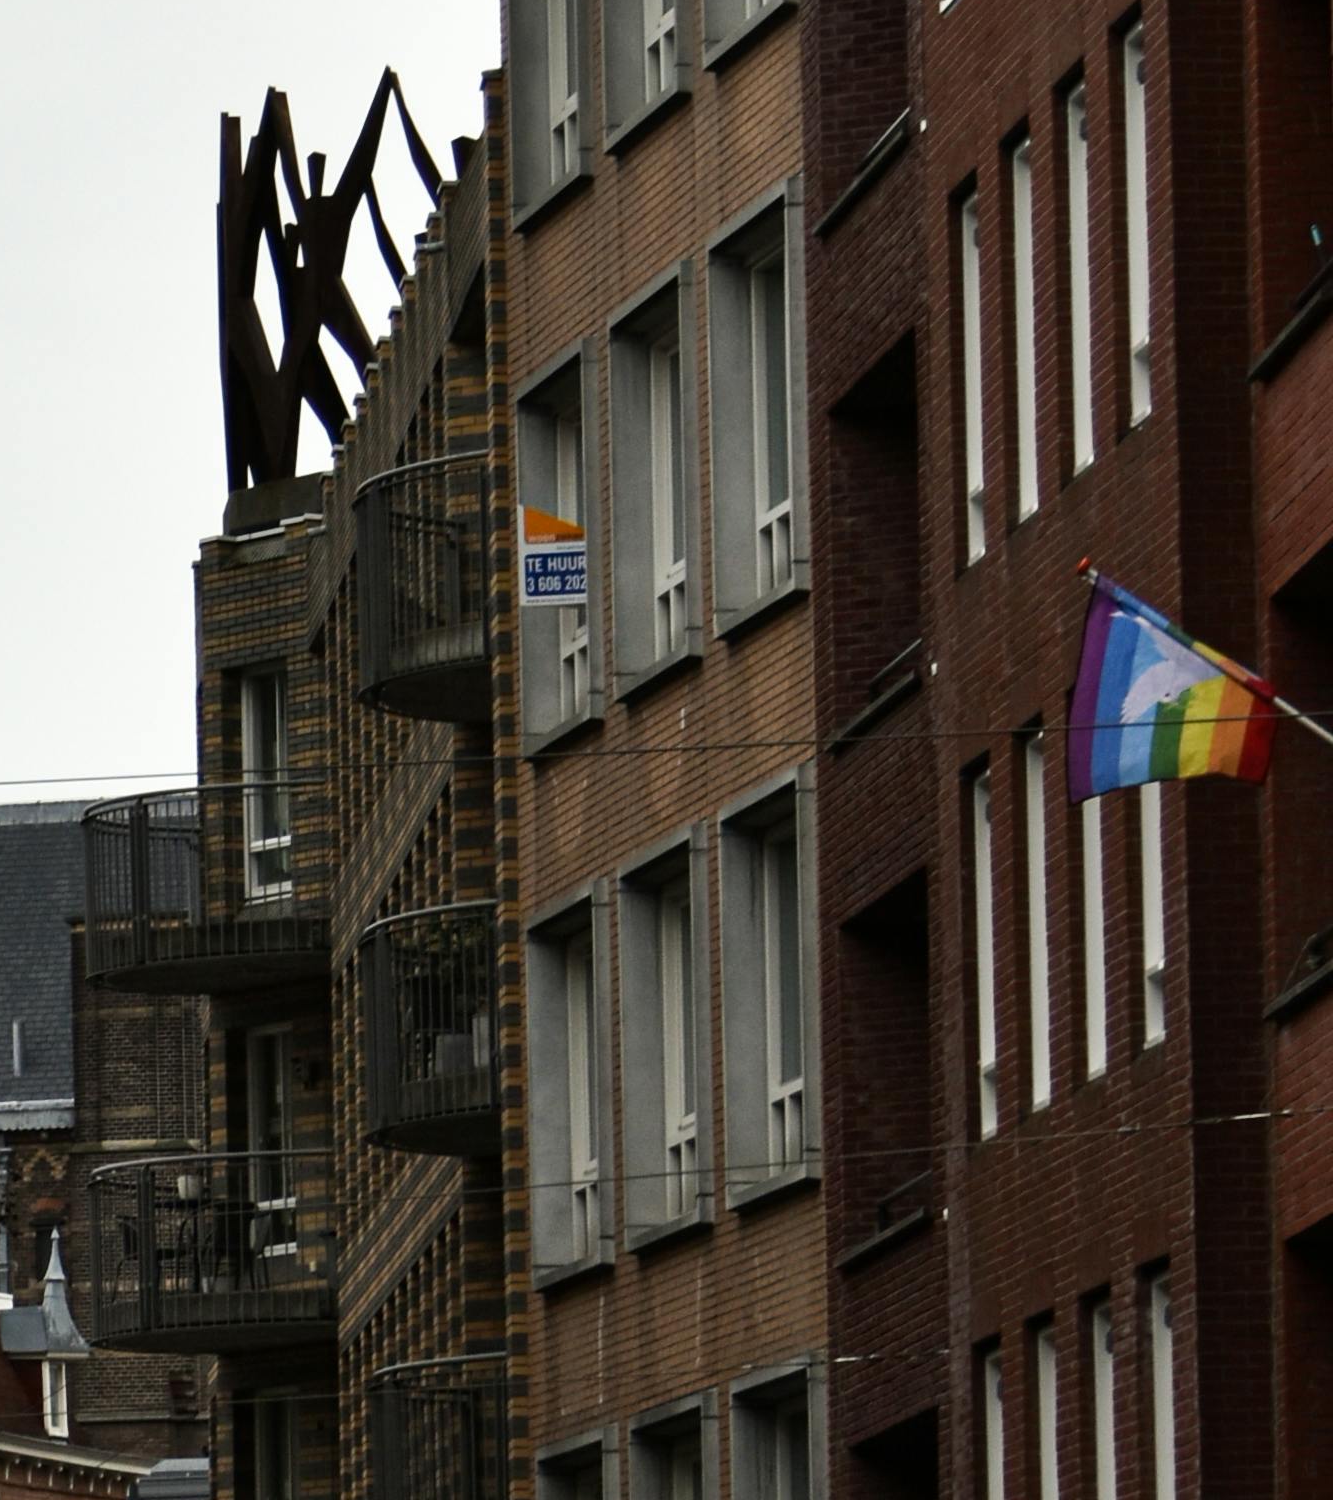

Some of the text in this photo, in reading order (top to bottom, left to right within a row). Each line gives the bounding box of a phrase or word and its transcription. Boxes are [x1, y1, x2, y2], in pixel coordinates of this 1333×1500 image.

[526, 555, 587, 573] TE HUUR
[527, 576, 535, 593] 3
[538, 575, 562, 592] 606
